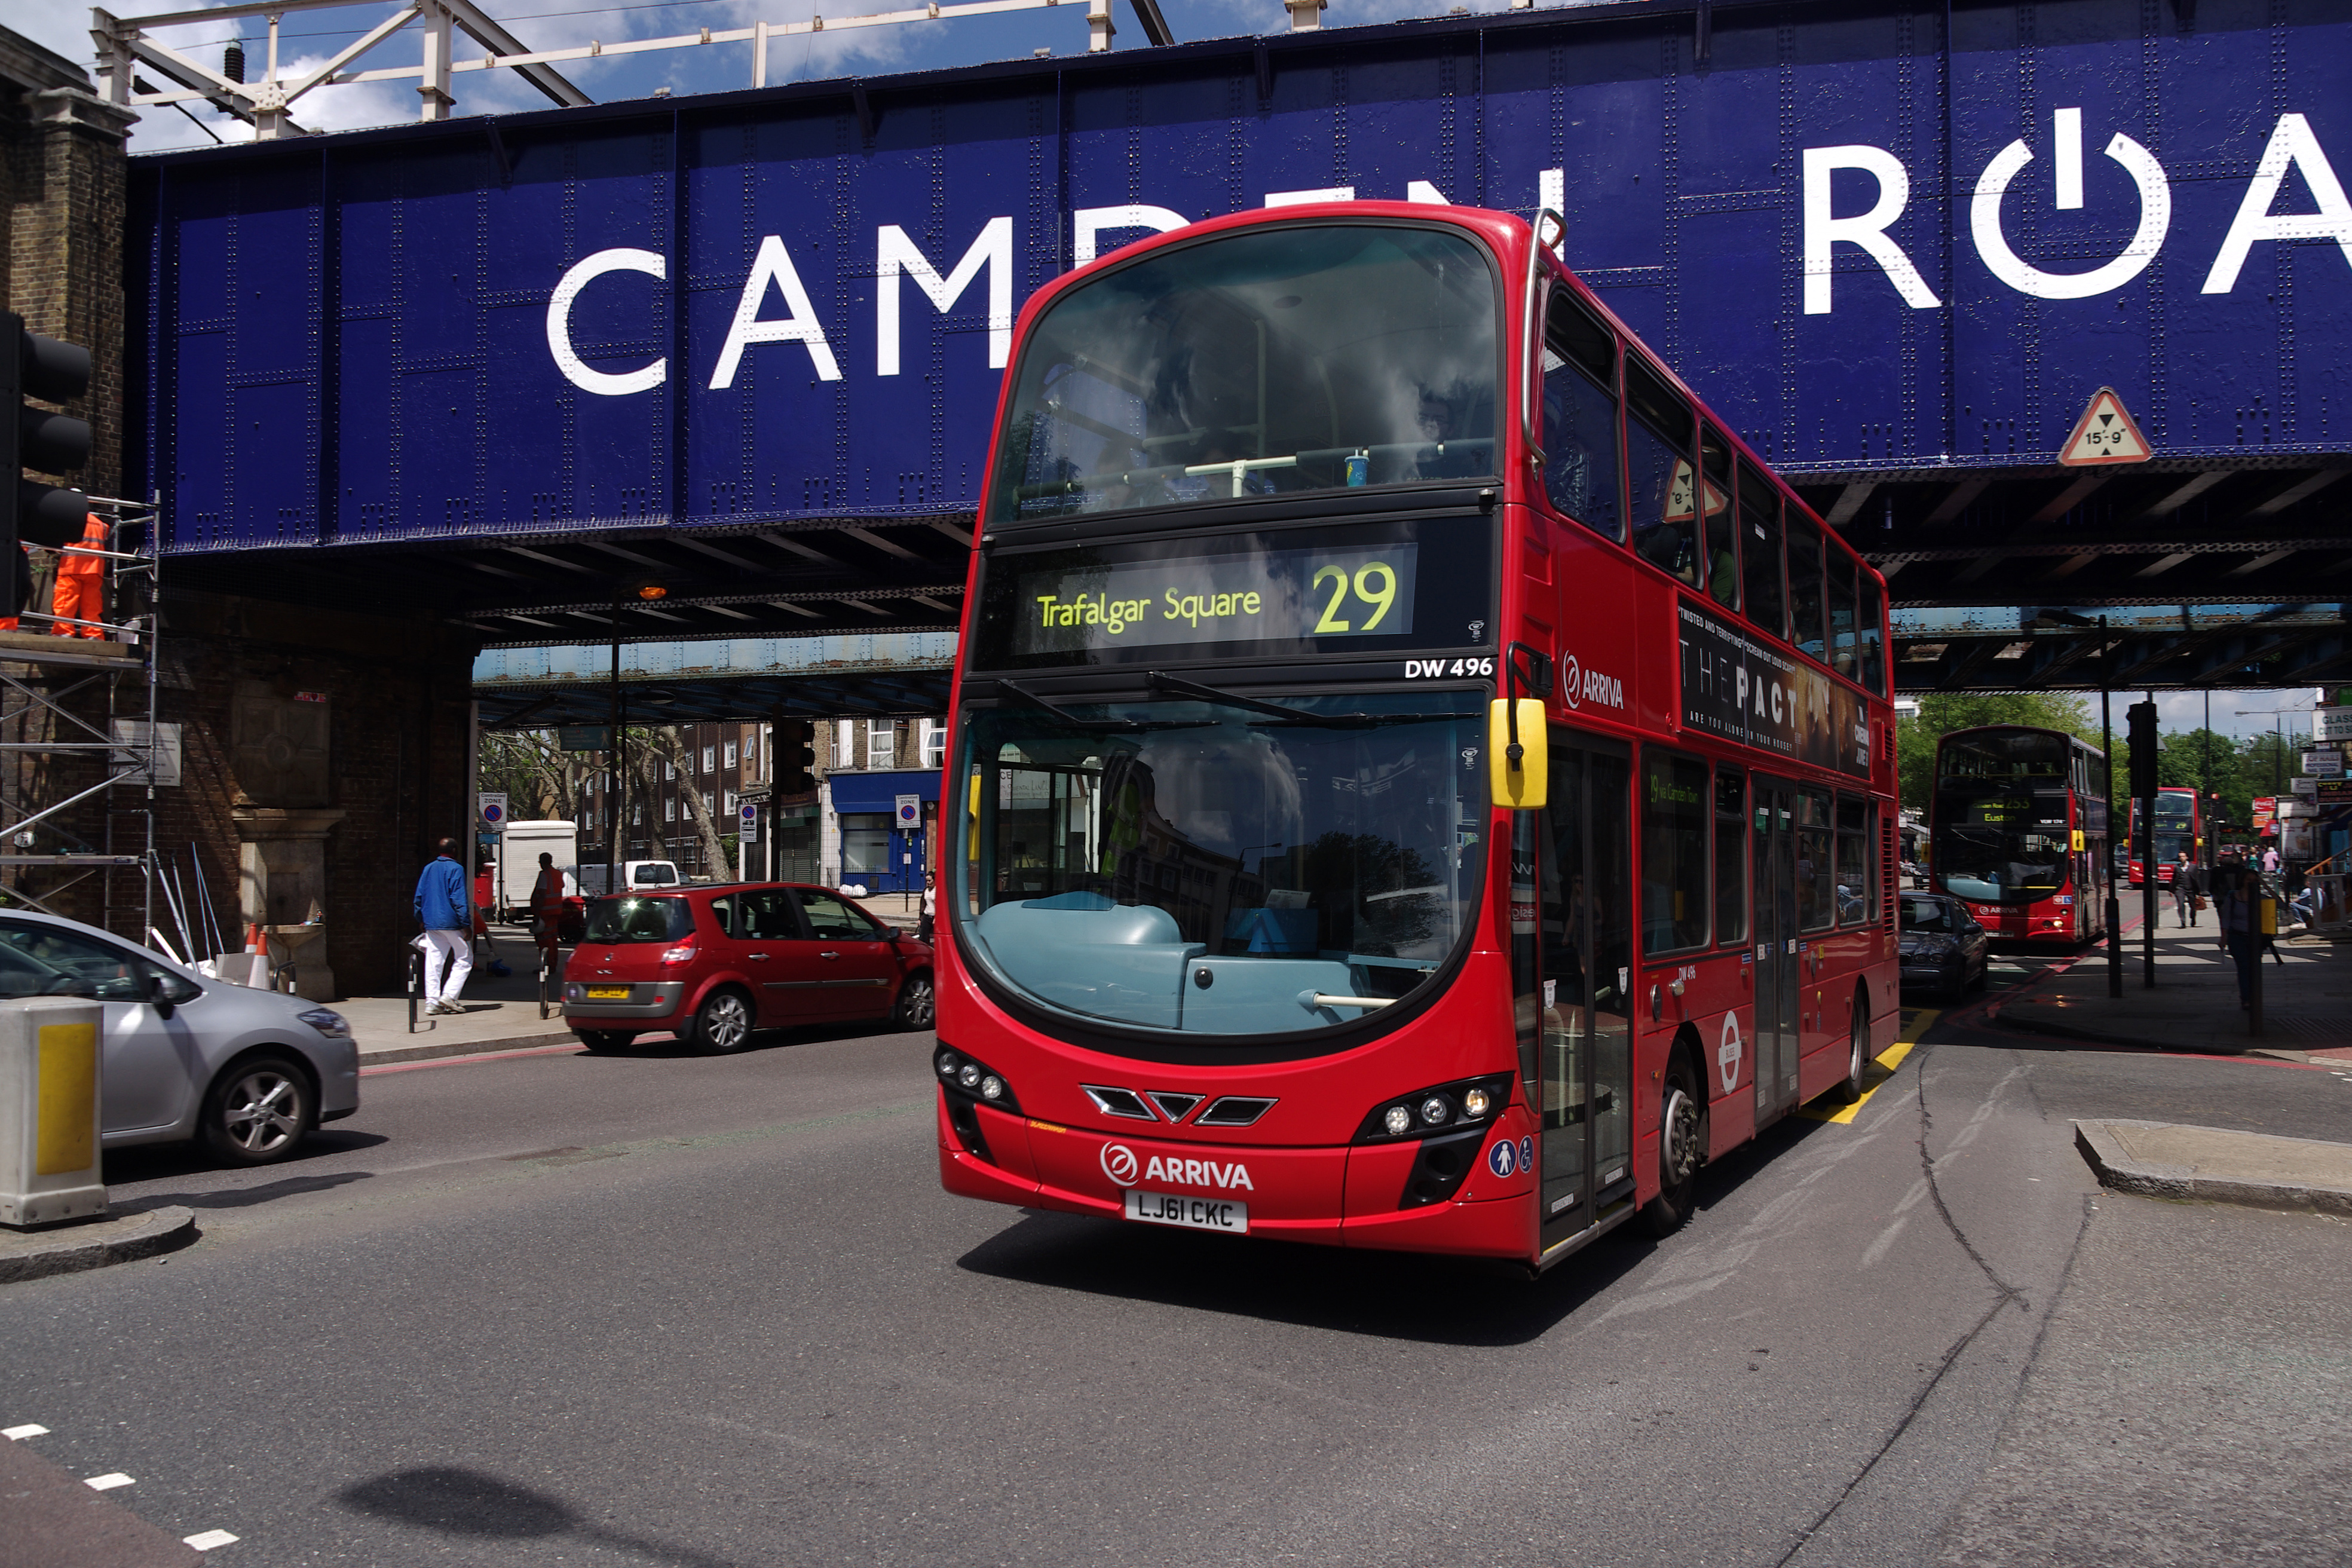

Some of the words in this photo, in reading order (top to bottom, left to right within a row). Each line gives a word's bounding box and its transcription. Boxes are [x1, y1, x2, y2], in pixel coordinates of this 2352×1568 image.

[1037, 593, 1151, 634] Trafalgar
[1163, 587, 1261, 628] Square
[1313, 561, 1397, 633] 29
[1705, 619, 1716, 634] AND
[1405, 660, 1444, 679] DW
[1450, 658, 1493, 677] 496
[1763, 651, 1771, 664] OUT
[1772, 655, 1782, 669] LOUD
[1582, 669, 1624, 710] ARRIVA
[1679, 638, 1728, 703] THE
[1735, 666, 1797, 728] PACT
[1690, 710, 1704, 724] ARE
[1708, 716, 1721, 730] YOU
[1725, 722, 1744, 737] ALONE
[1756, 733, 1771, 746] YOUR
[1668, 783, 1686, 802] Camden
[2005, 797, 2031, 810] 253
[1984, 813, 2016, 822] Euston
[1679, 966, 1688, 981] DW
[1687, 964, 1696, 980] 496
[1725, 1047, 1735, 1059] BUSES
[1144, 1156, 1254, 1191] ARRIVA
[1138, 1196, 1186, 1222] LJ61
[1190, 1199, 1234, 1228] CKC
